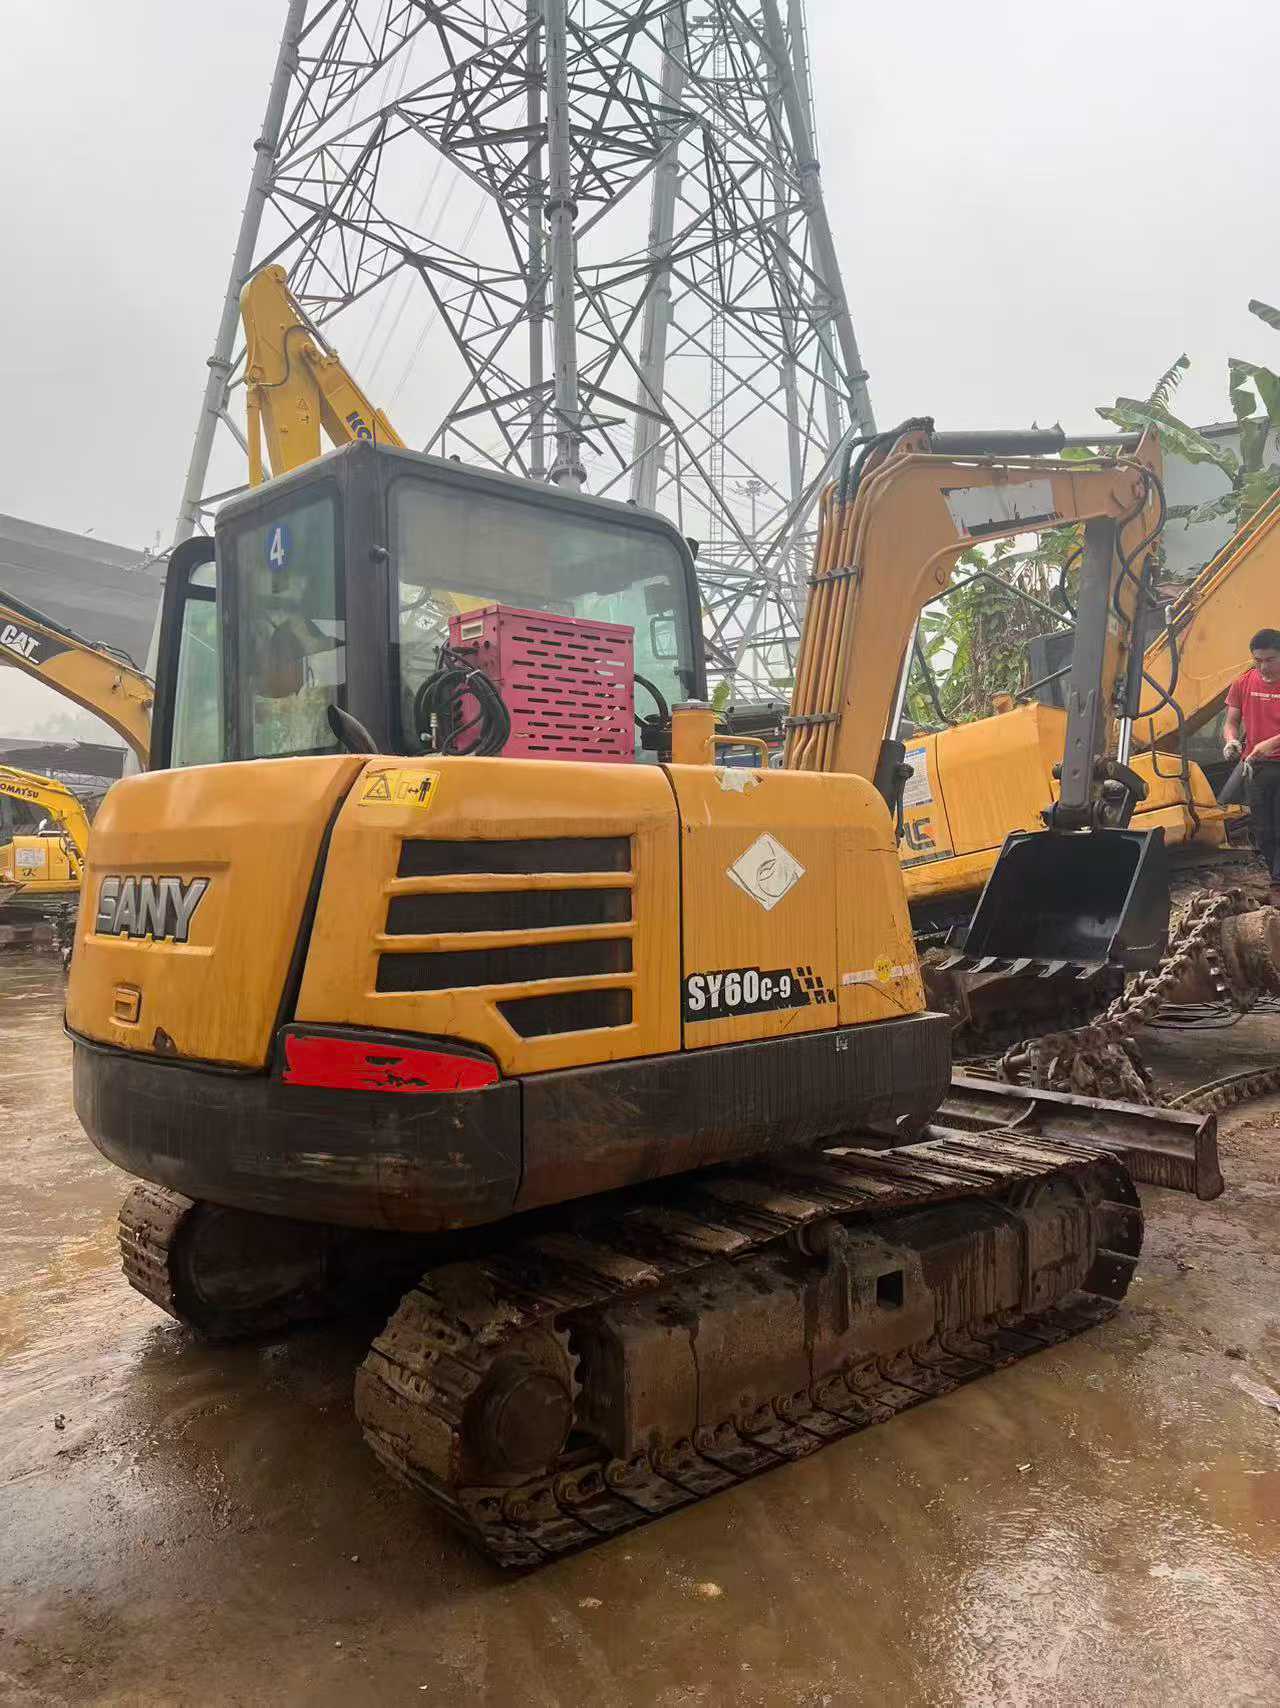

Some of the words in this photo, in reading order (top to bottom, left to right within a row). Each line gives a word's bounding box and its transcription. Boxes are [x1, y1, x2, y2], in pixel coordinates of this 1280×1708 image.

[270, 527, 285, 566] 4
[0, 624, 40, 658] CAT
[96, 875, 210, 943] SANY
